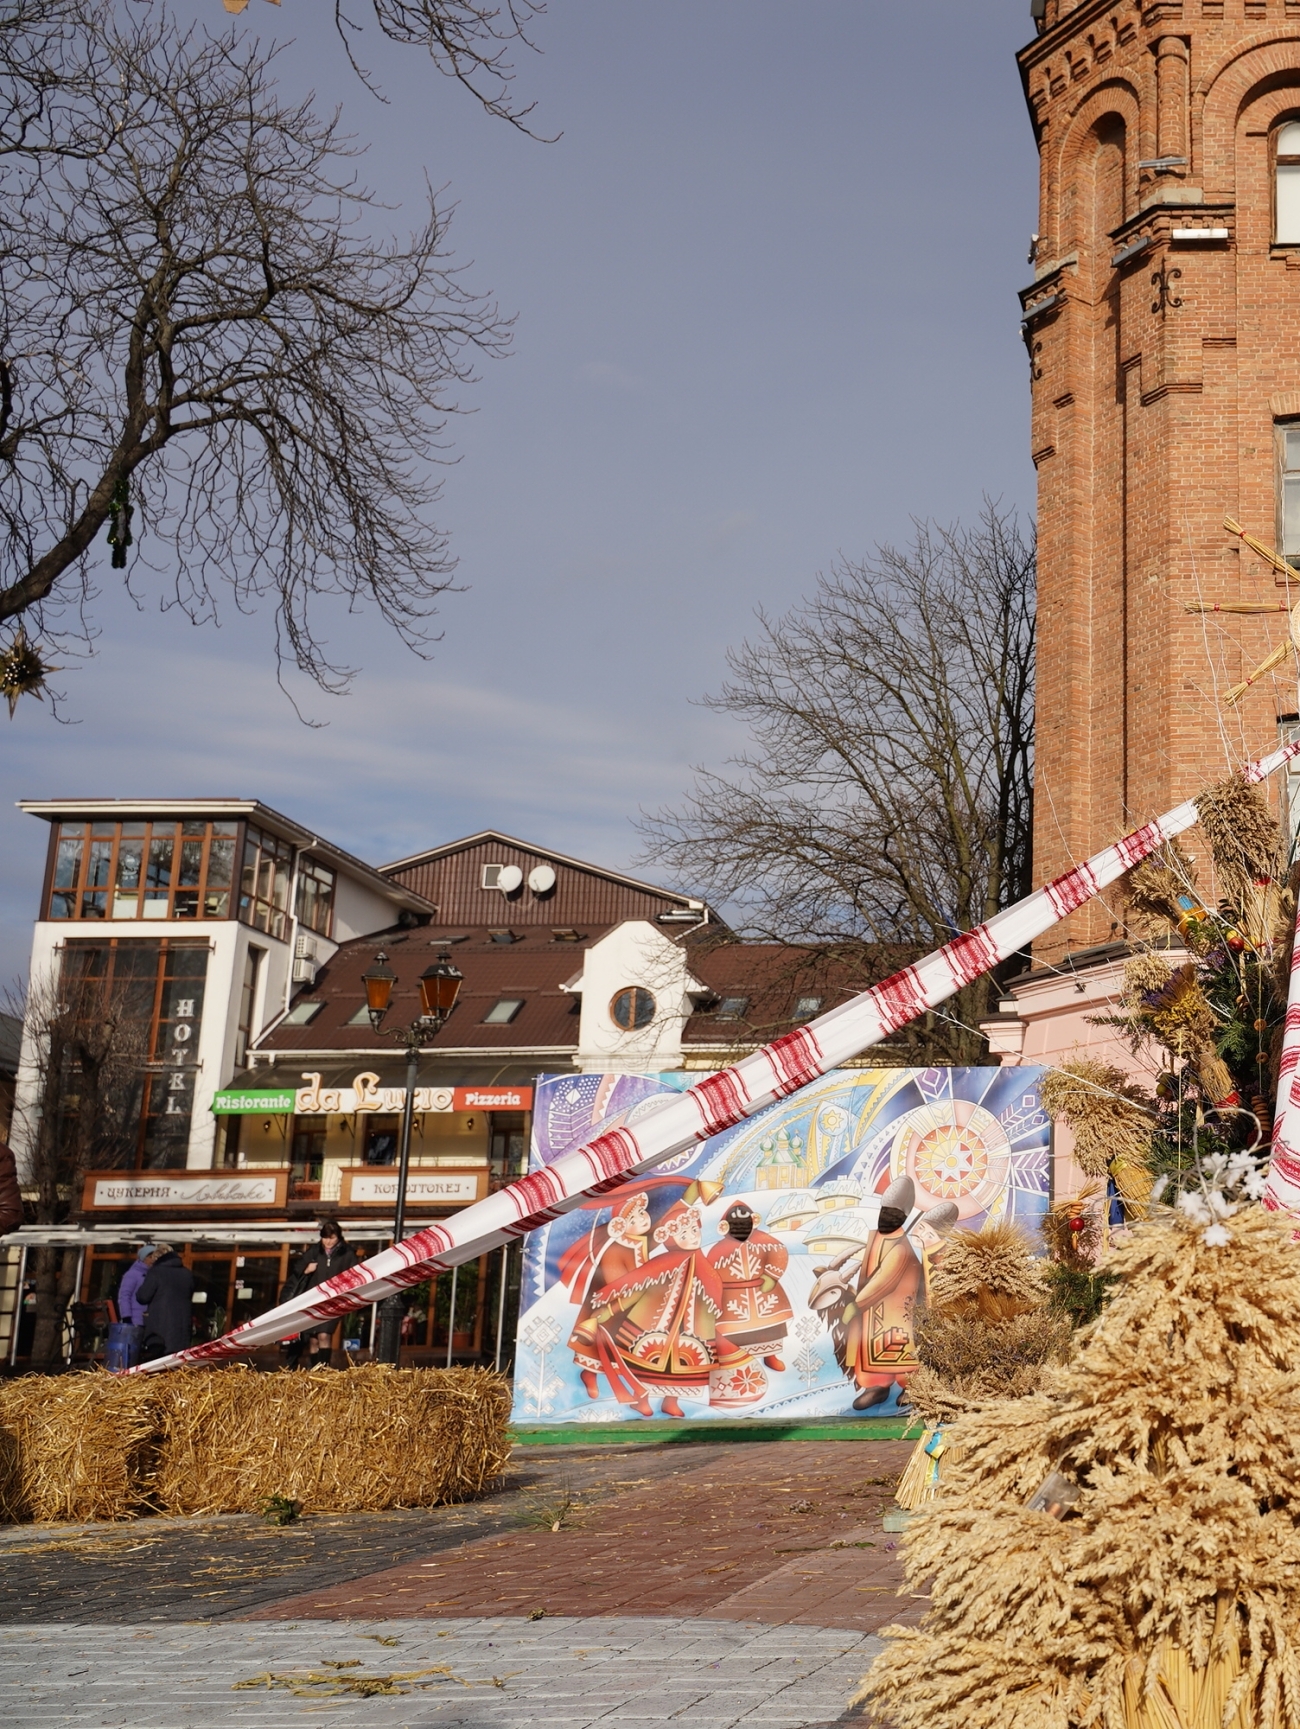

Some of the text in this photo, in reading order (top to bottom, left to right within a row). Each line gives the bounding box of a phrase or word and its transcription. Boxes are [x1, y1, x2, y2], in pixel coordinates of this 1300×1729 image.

[165, 999, 195, 1114] HOTEL
[296, 1072, 453, 1112] da Lucio
[465, 1092, 521, 1106] Pizzeria
[216, 1095, 291, 1110] Ristorante
[107, 1186, 172, 1200] ЦУКЕРНЯ
